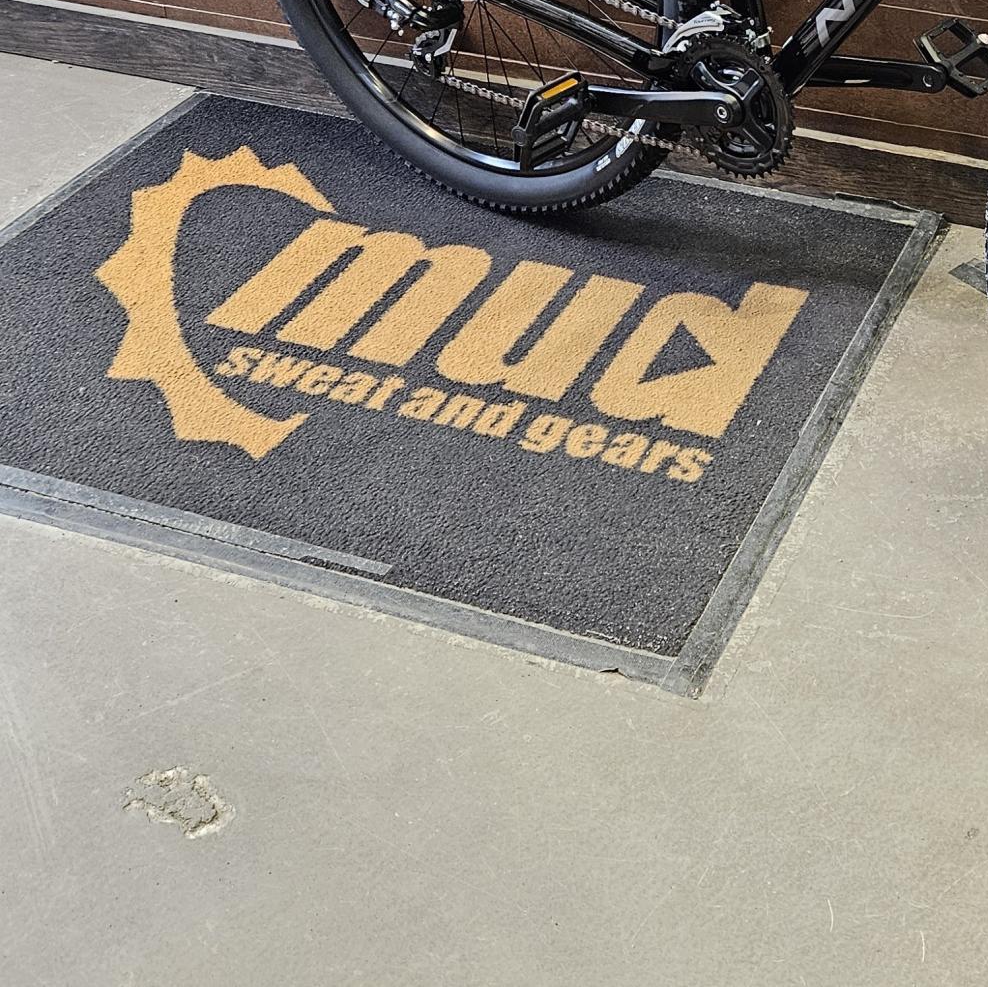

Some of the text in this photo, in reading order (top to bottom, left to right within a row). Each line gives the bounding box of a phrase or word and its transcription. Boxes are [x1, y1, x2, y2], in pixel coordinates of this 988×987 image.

[206, 217, 808, 439] mud
[216, 342, 716, 483] sweat and gears
